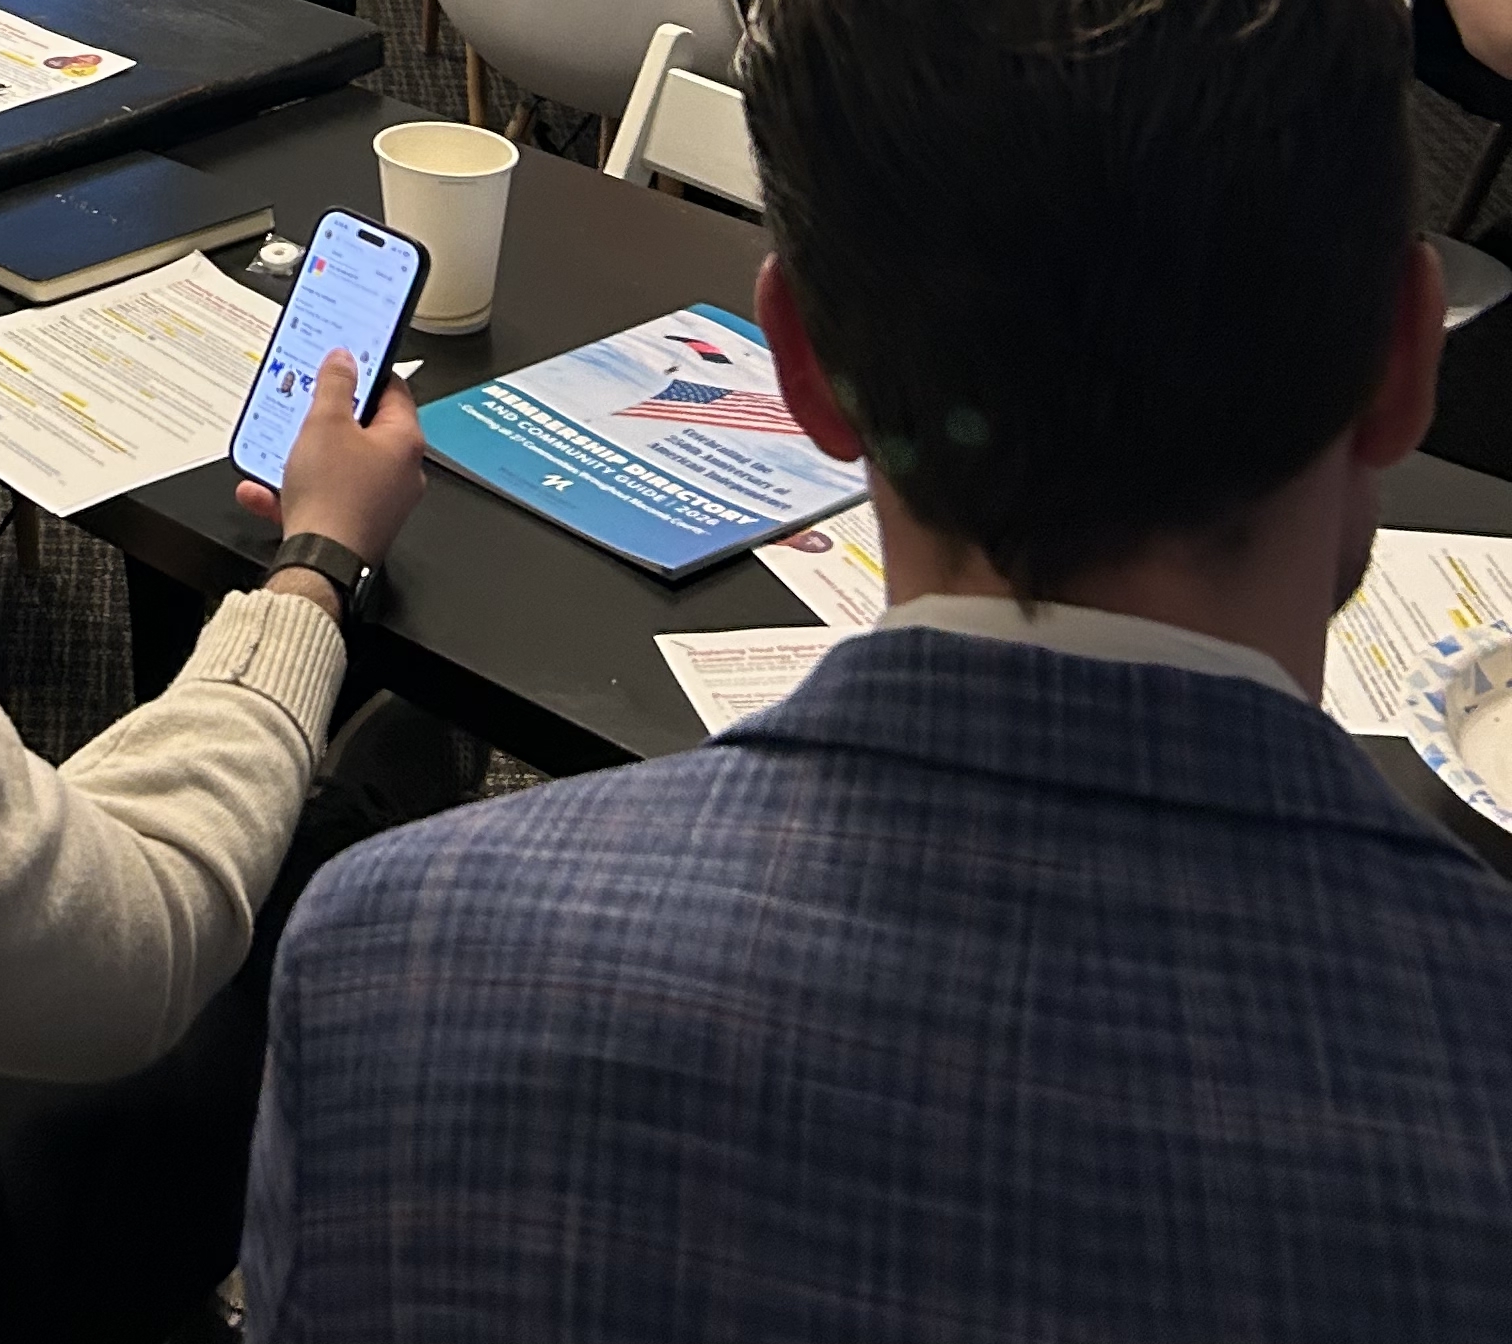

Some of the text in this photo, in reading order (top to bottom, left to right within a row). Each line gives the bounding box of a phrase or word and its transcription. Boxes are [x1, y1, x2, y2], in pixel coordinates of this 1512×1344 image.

[481, 401, 519, 421] AND
[517, 421, 617, 474] COMMUNITY
[614, 474, 669, 503] GUIDE
[481, 385, 628, 465] MEMBERSHIP
[623, 463, 760, 525] DIRECTORY
[647, 441, 707, 473] American
